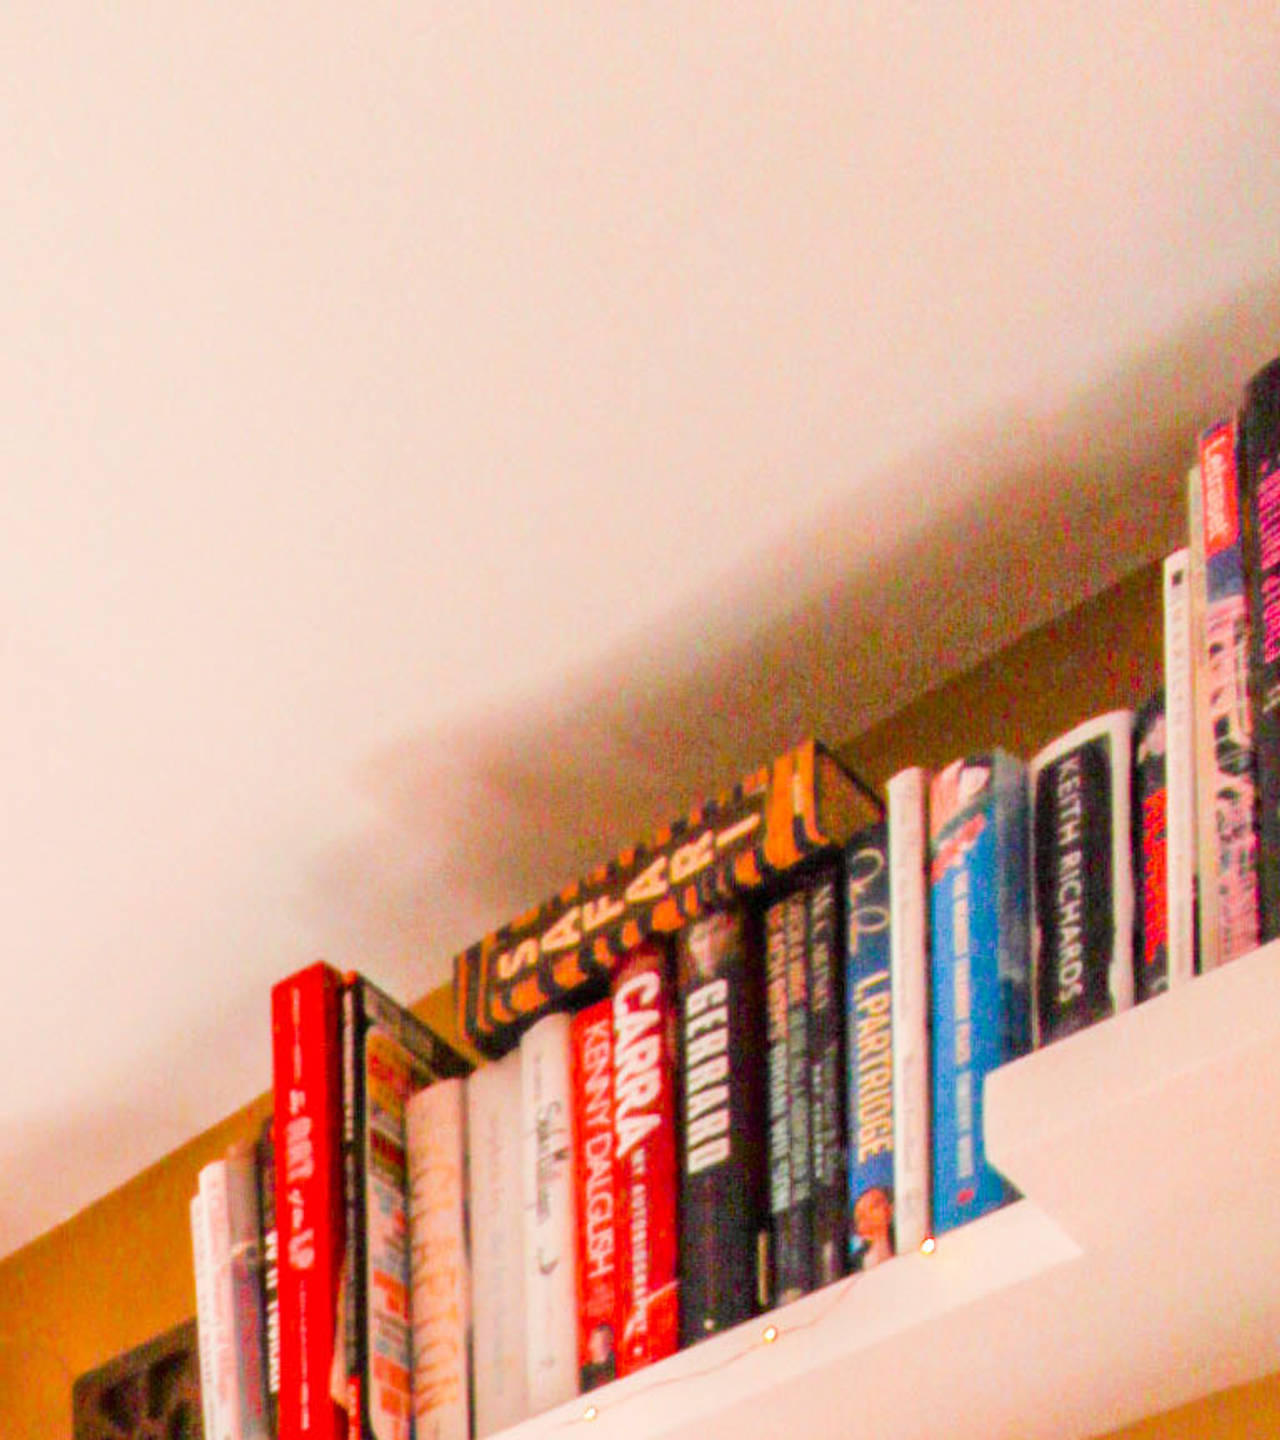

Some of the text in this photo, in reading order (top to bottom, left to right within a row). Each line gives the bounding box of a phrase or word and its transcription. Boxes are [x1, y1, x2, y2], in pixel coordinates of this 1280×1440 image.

[497, 812, 762, 980] SAFARI
[1058, 756, 1083, 1004] KEITH RICHARDS
[285, 1116, 314, 1181] ART
[583, 1019, 613, 1125] KENNY
[614, 971, 661, 1159] CARRA
[685, 978, 729, 1175] GERRARD
